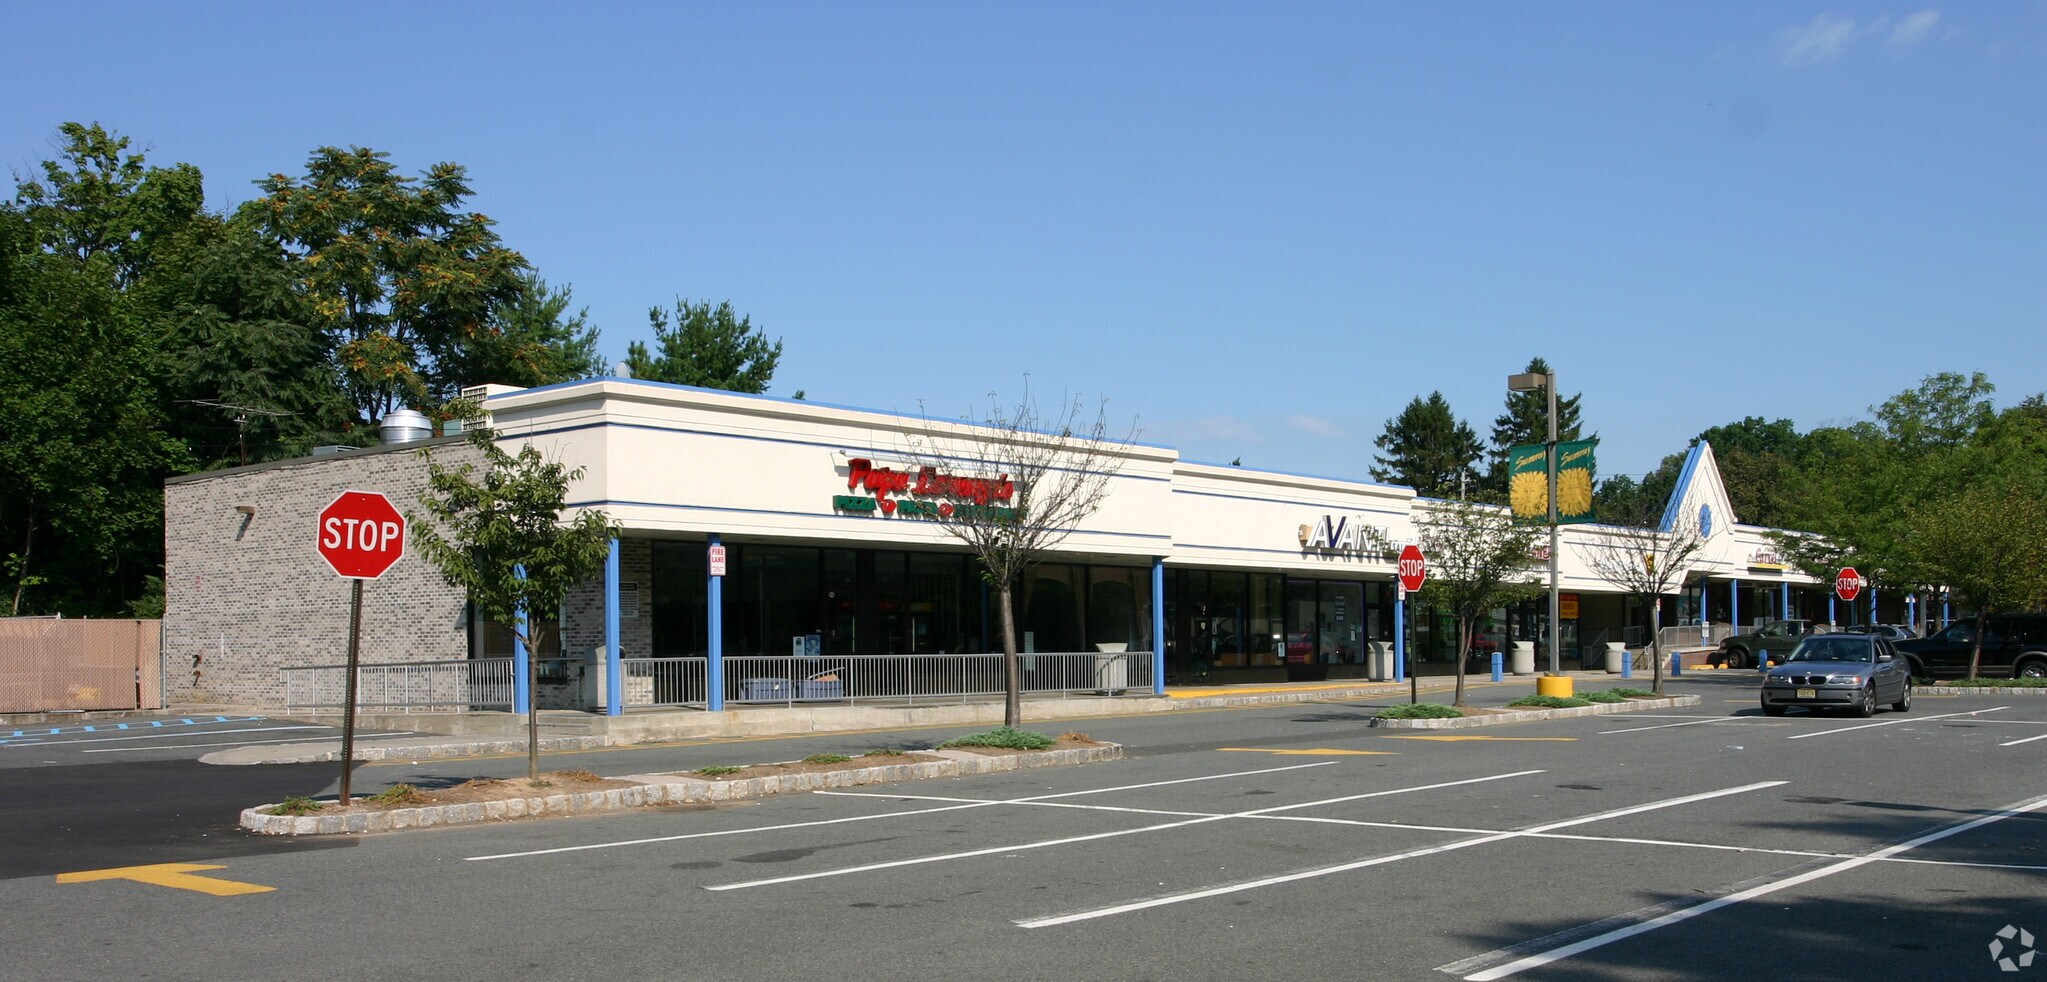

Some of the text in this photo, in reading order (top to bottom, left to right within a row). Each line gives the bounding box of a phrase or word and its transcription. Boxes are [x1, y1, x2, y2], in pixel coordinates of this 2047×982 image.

[323, 517, 400, 552] STOP
[711, 547, 725, 556] FIRE
[1400, 559, 1424, 577] STOP
[1837, 578, 1858, 590] STOP
